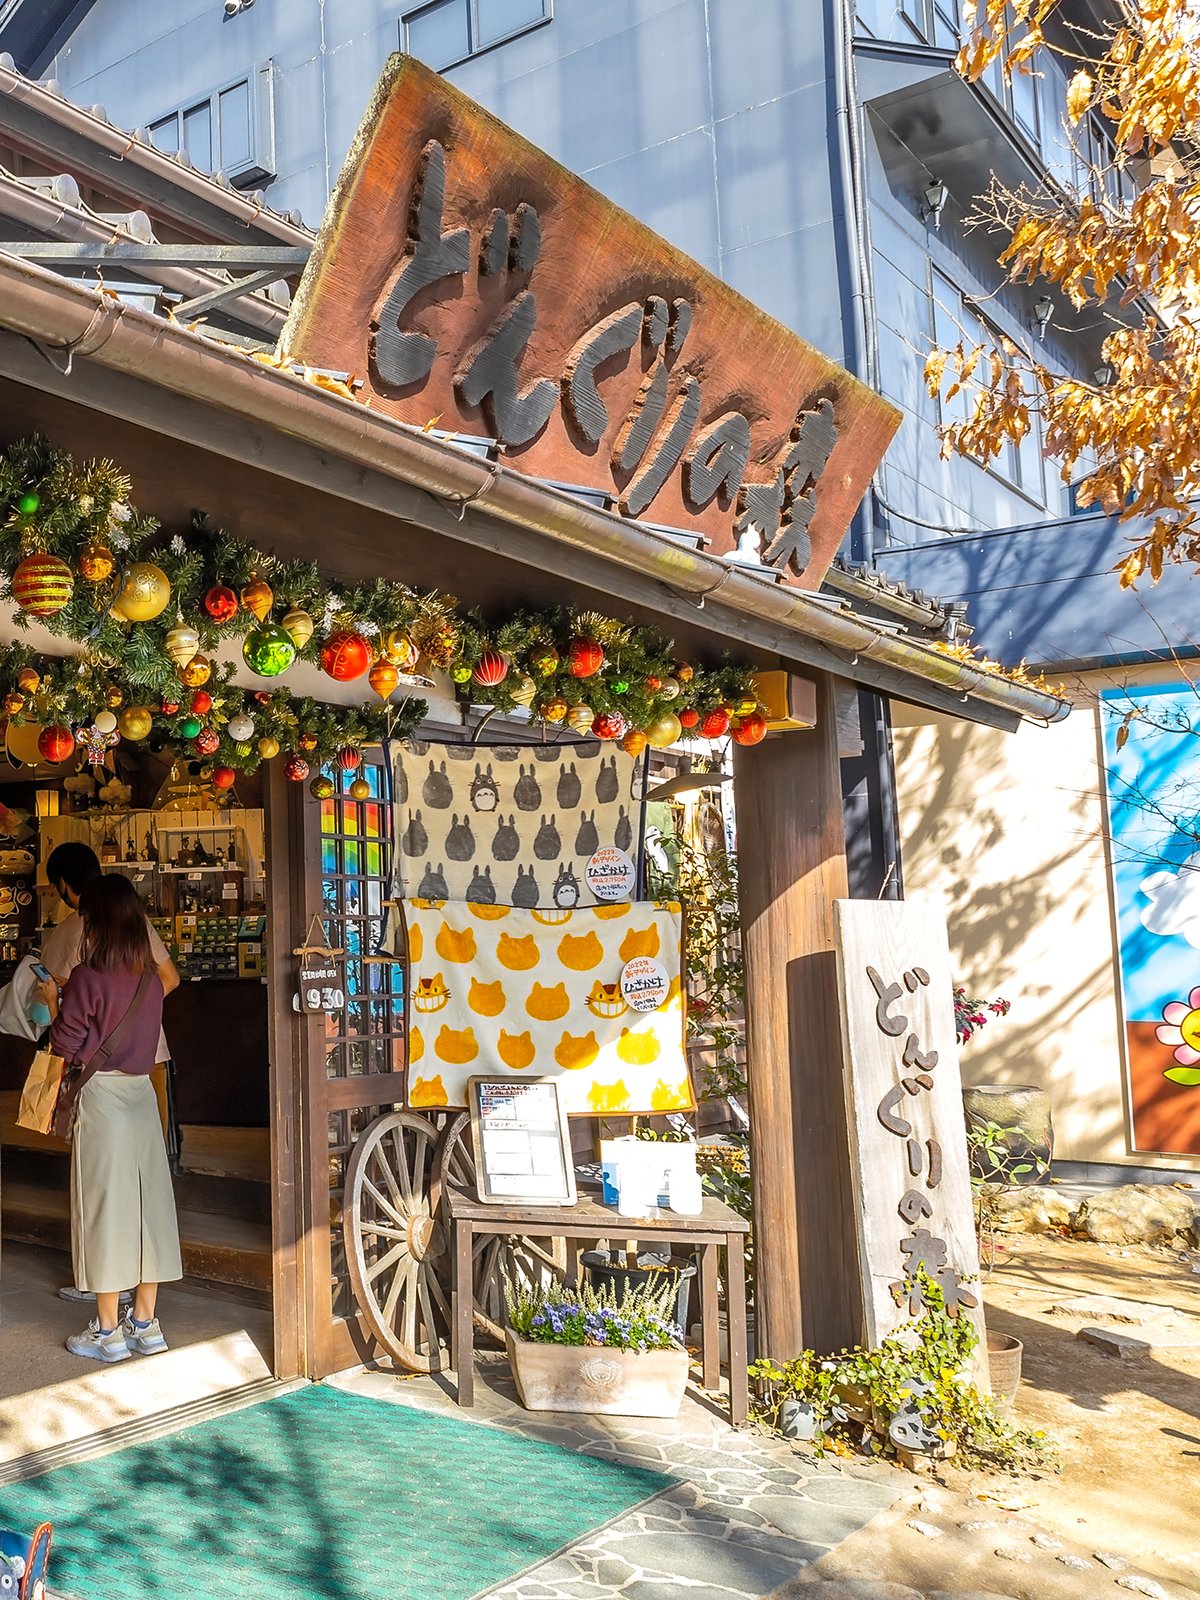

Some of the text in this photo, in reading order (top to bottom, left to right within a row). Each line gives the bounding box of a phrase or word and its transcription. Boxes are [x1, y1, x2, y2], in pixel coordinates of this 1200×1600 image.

[368, 138, 840, 577] どんぐりの森
[587, 864, 629, 877] ひざかけ
[624, 976, 664, 993] ひざかけ
[866, 965, 978, 1318] どんぐりの森
